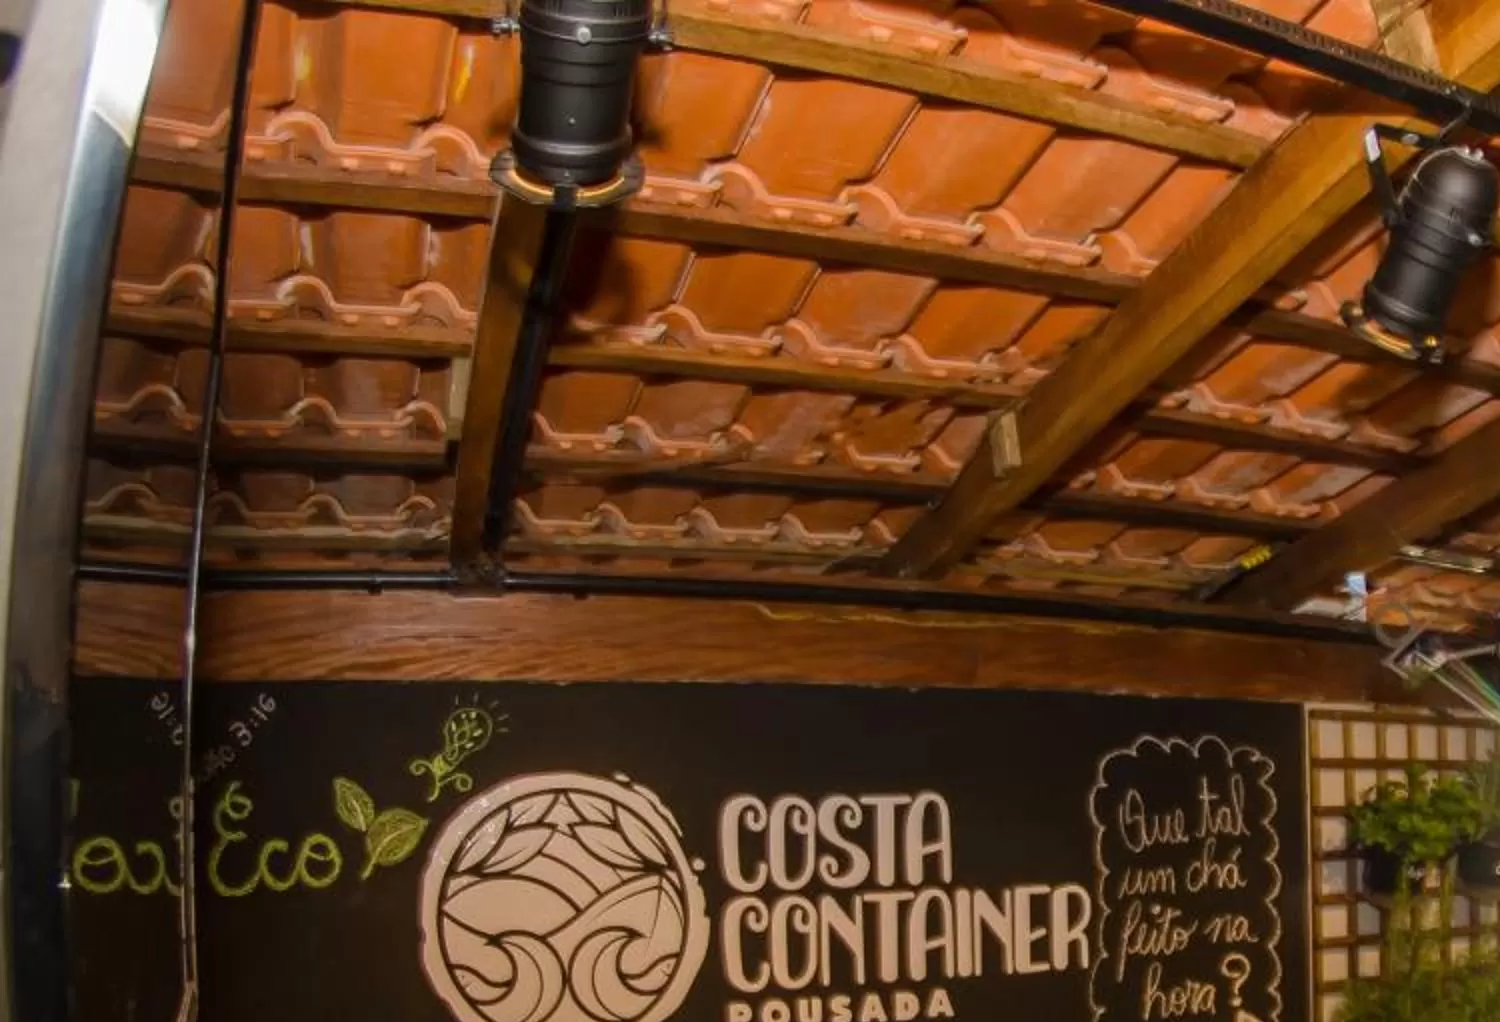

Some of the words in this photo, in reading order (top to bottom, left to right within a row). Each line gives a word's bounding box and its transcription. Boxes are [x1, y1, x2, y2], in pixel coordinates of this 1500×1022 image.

[228, 692, 277, 747] 3:16
[208, 780, 343, 898] Eco
[720, 792, 953, 894] COSTA
[1119, 788, 1190, 853] Que
[1197, 761, 1252, 837] tal
[1118, 866, 1177, 900] um
[1186, 836, 1249, 894] chá
[722, 881, 1093, 993] CONTAINER
[1115, 899, 1199, 983] feito
[1204, 913, 1259, 943] na
